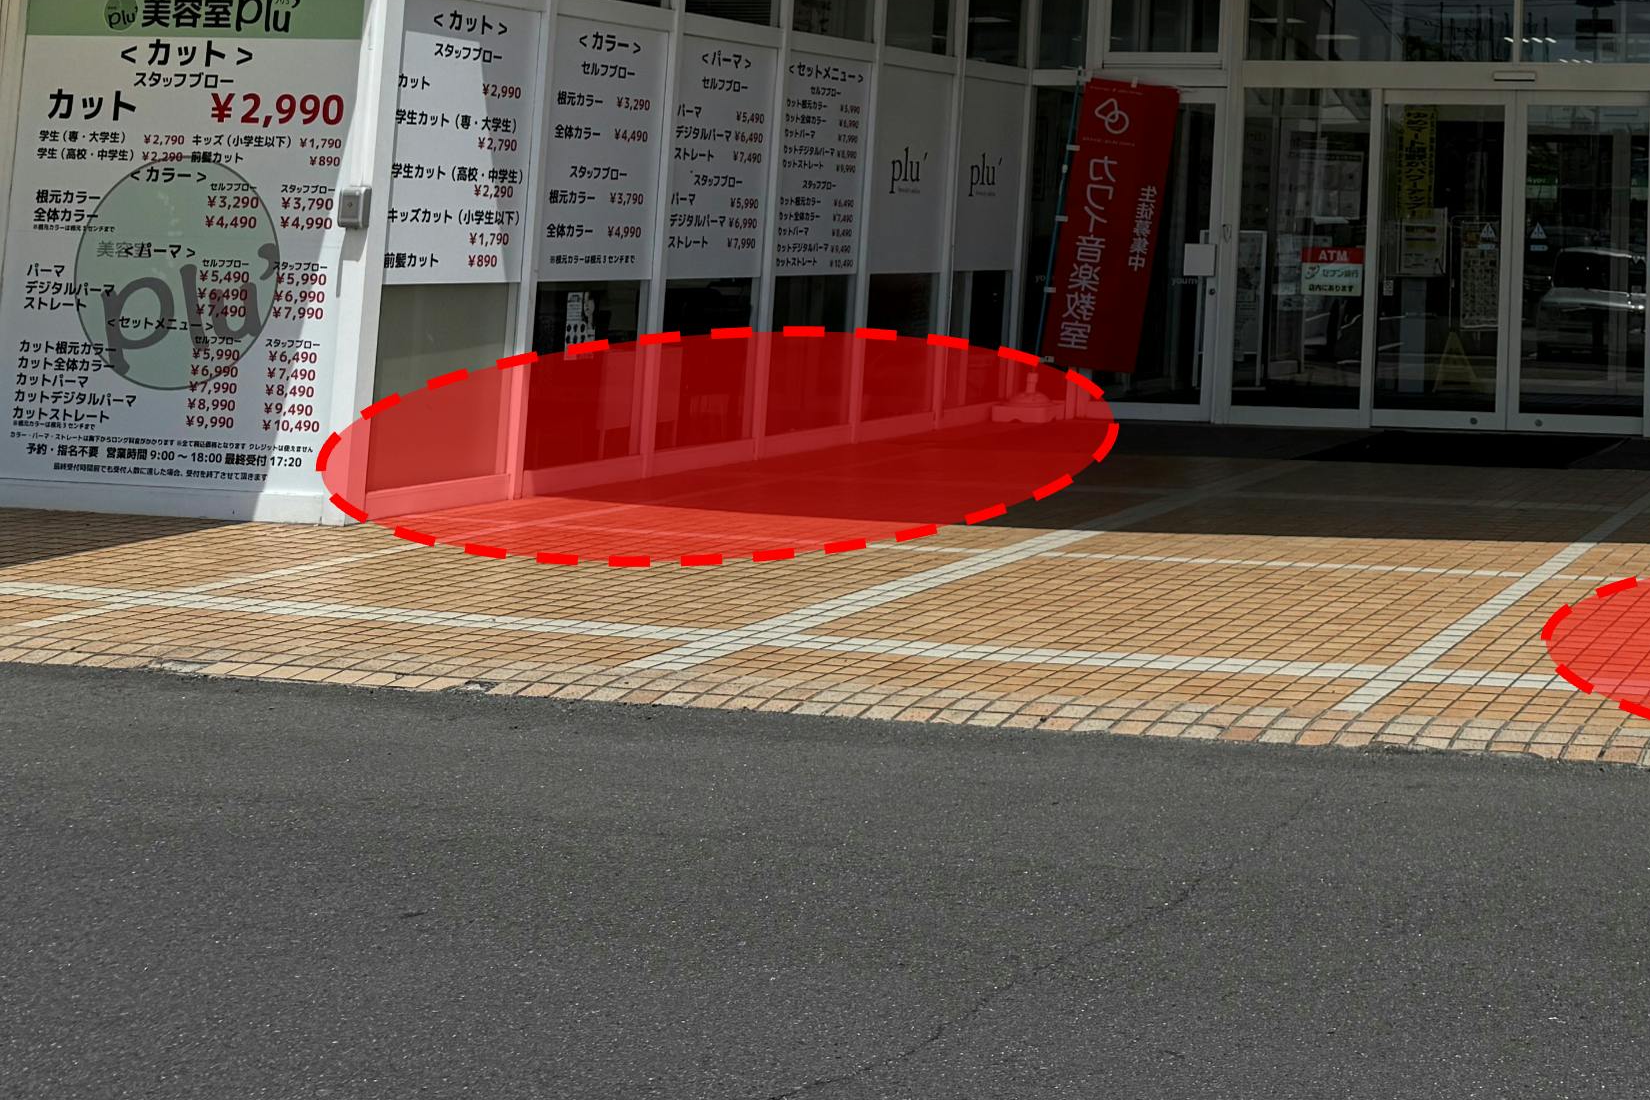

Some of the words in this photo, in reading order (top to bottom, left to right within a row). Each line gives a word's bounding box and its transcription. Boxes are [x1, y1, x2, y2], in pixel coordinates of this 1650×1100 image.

[435, 43, 502, 63] スタッフブロー
[582, 61, 635, 78] セルフブロー
[134, 72, 233, 88] スタッフブロー
[399, 73, 430, 89] カット
[483, 84, 521, 99] ¥2,990
[702, 76, 748, 93] セルフブロー
[811, 86, 841, 97] セルフブロー
[48, 89, 136, 121] カット
[211, 93, 344, 127] ¥2,990
[558, 91, 603, 107] 根元カラー
[617, 97, 650, 111] ¥3,290
[678, 104, 701, 118] パーマ
[736, 111, 764, 124] ¥5,490
[555, 124, 600, 140] 全体カラー
[614, 128, 648, 142] ¥4,490
[676, 126, 731, 142] デジタルパーマ
[735, 131, 763, 144] ¥6,490
[144, 135, 184, 145] ¥2,790
[300, 138, 341, 148] ¥1,790
[478, 138, 517, 151] ¥2,790
[142, 152, 182, 162] ¥2,290
[191, 151, 243, 163] 前髪カット
[310, 156, 340, 166] ¥890
[675, 148, 714, 160] ストレート
[733, 151, 761, 163] ¥7,490
[570, 165, 627, 180] スタッフブロー
[211, 183, 257, 191] セルフブロー
[281, 185, 335, 194] スタッフブロー
[694, 175, 743, 187] スタッフブロー
[803, 180, 836, 189] スタッフブロー
[475, 185, 513, 198] ¥2,290
[550, 189, 595, 204] 根元カラー
[610, 192, 643, 205] ¥3,790
[36, 190, 100, 204] 根元カラー
[208, 196, 258, 209] ¥3,290
[282, 197, 333, 210] ¥3,790
[671, 193, 695, 205] パーマ
[731, 198, 758, 209] ¥5,990
[34, 208, 98, 223] 全体カラー
[205, 216, 256, 229] ¥4,490
[281, 217, 332, 230] ¥4,990
[670, 214, 726, 228] デジタルパーマ
[729, 217, 757, 229] ¥6,990
[470, 233, 509, 245] ¥1,790
[547, 224, 593, 238] 全体カラー
[608, 226, 641, 238] ¥4,990
[668, 236, 708, 249] ストレート
[728, 237, 755, 249] ¥7,990
[384, 252, 438, 268] 前髪カット
[468, 254, 497, 267] ¥890
[1319, 250, 1347, 260] ATM
[202, 259, 249, 267] セルフブロー
[273, 261, 327, 271] スタッフブロー
[1323, 269, 1359, 277] セブン銀行
[27, 264, 64, 277] パーマ
[199, 271, 249, 283] ¥5,490
[276, 273, 326, 285] ¥5,990
[25, 282, 115, 297] デジタルパーマ
[197, 288, 248, 301] ¥6,490
[274, 291, 325, 303] ¥6,990
[1309, 284, 1354, 292] 店内にあります
[24, 296, 86, 310] ストレート
[196, 305, 246, 318] ¥7,490
[273, 307, 323, 320] ¥7,990
[195, 336, 241, 344] セルフブロー
[266, 339, 320, 348] スタッフブロー
[20, 341, 116, 354] カット根元カラー
[193, 348, 240, 361] ¥5,990
[269, 350, 317, 364] ¥6,490
[18, 357, 115, 371] カット全体カラー
[191, 365, 238, 378] ¥6,990
[267, 367, 316, 380] ¥7,490
[16, 373, 88, 387] カットパーマ
[189, 382, 237, 394] ¥7,990
[266, 384, 314, 397] ¥8,490
[15, 387, 136, 407] カットデジタルパーマ
[188, 398, 235, 411] ¥8,990
[264, 402, 313, 416] ¥9,490
[13, 406, 109, 422] カットストレート
[186, 415, 234, 428] ¥9,990
[263, 419, 319, 433] ¥10,490
[27, 443, 98, 458] 予約・指名不要
[107, 448, 147, 461] 営業時間
[151, 450, 174, 461] 9:00
[191, 452, 221, 463] 18:00
[225, 453, 266, 467] 最終受付
[270, 456, 301, 468] 17:20
